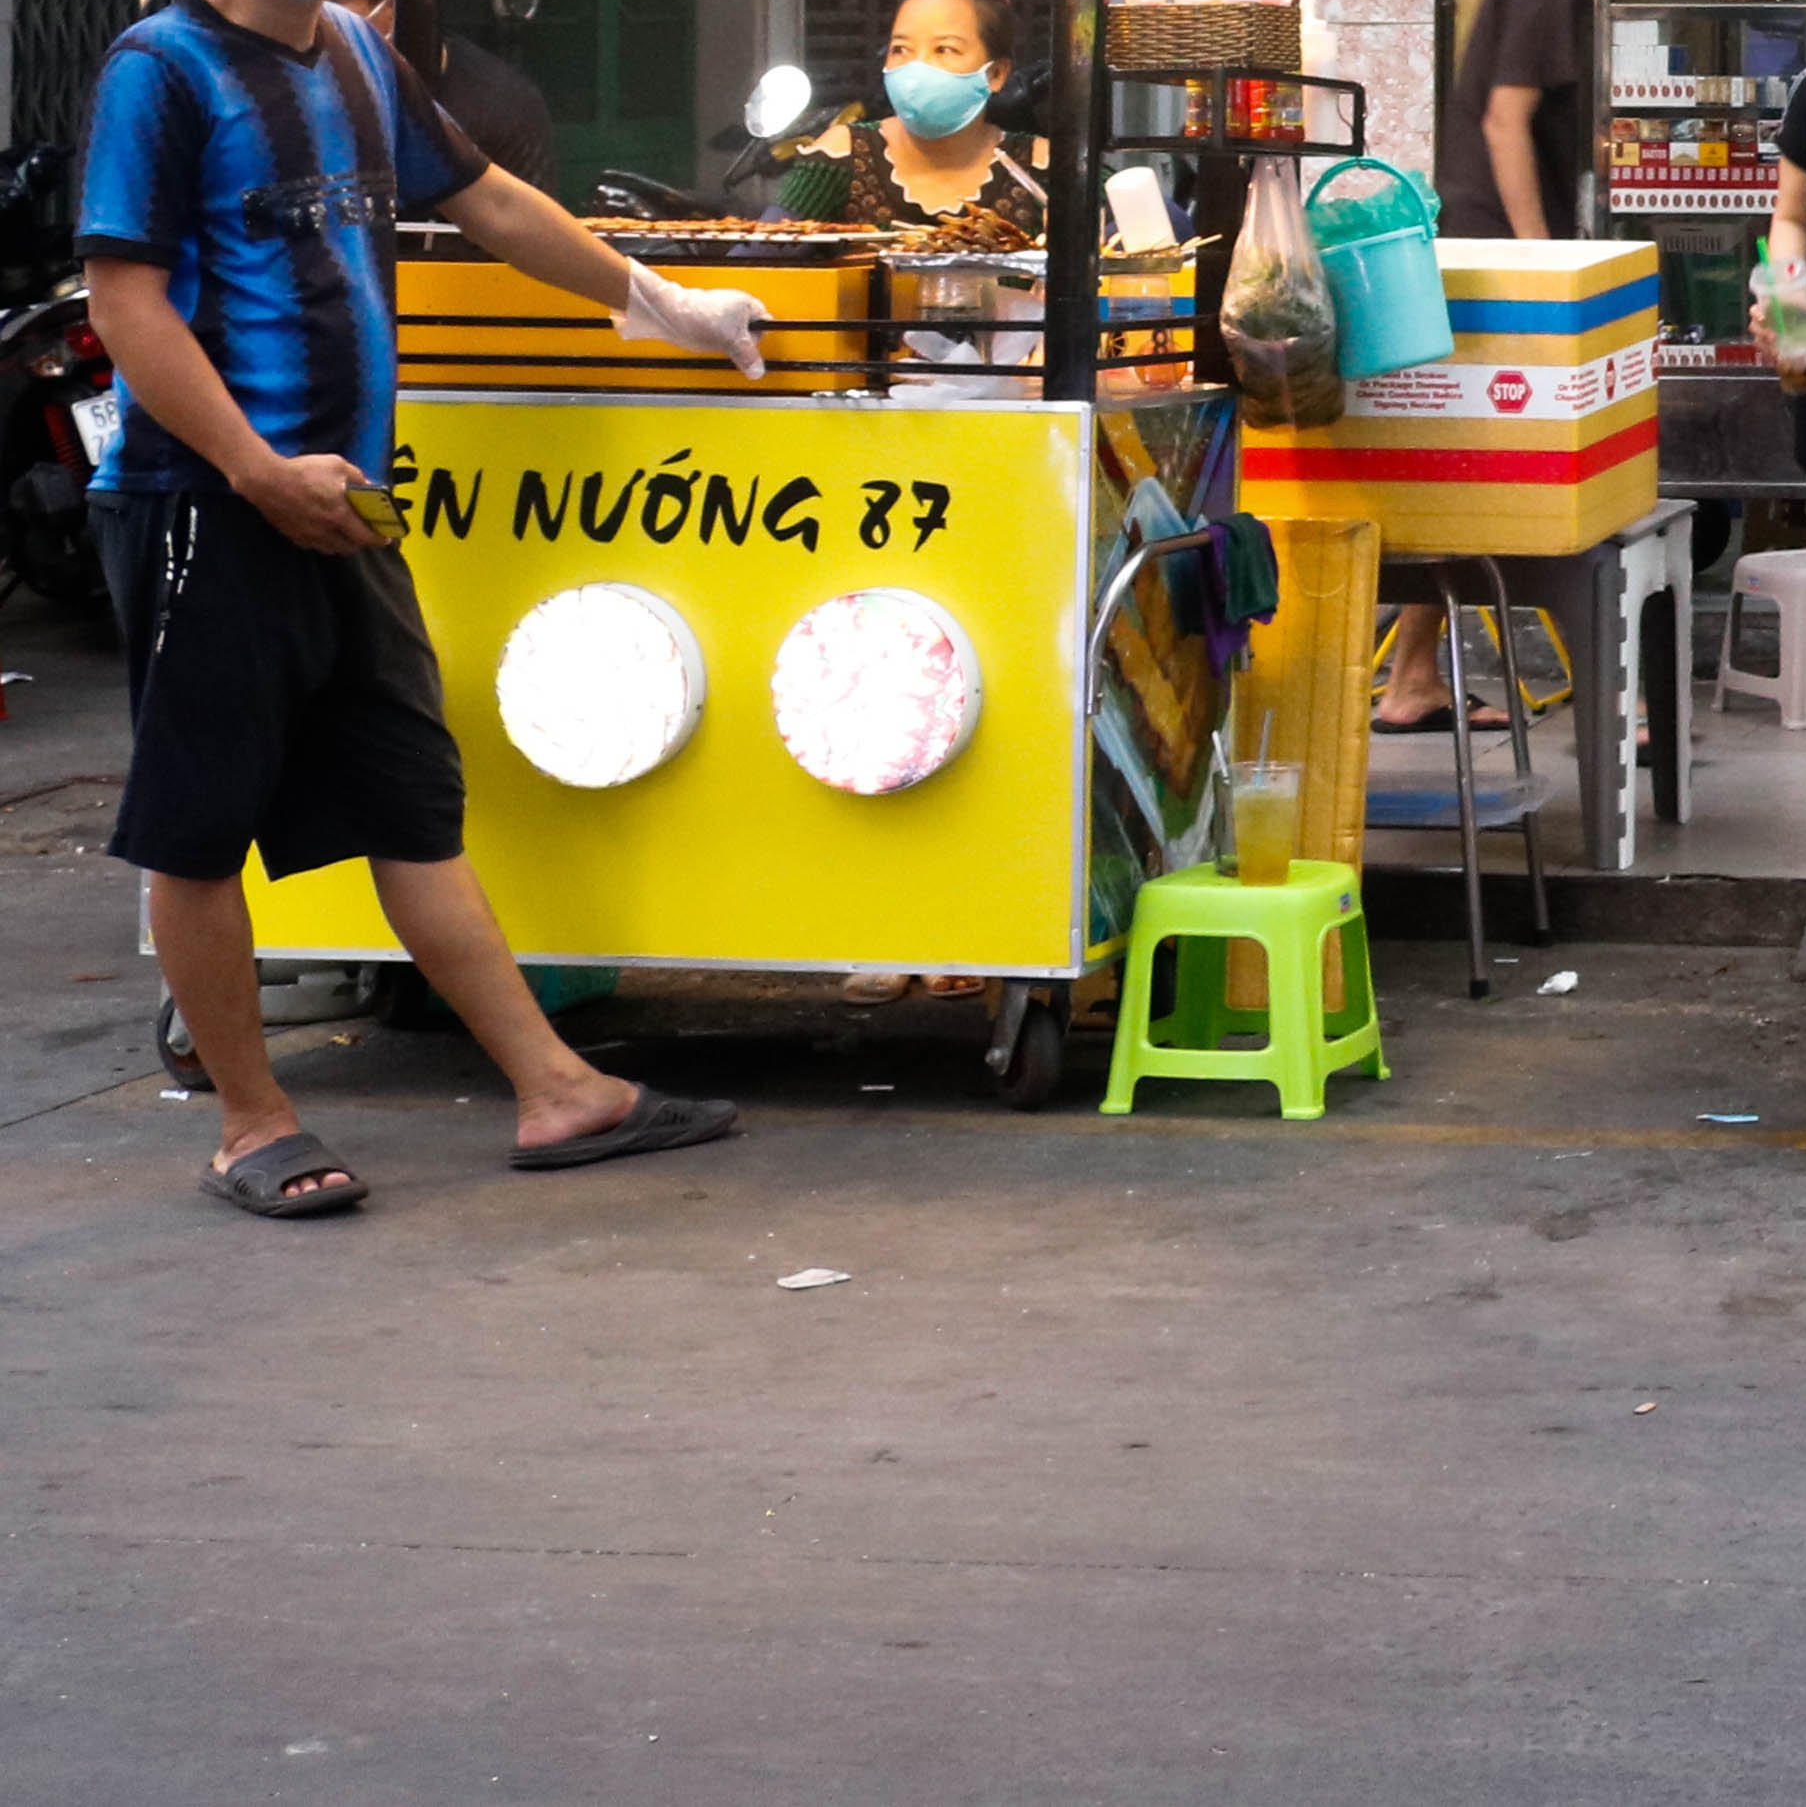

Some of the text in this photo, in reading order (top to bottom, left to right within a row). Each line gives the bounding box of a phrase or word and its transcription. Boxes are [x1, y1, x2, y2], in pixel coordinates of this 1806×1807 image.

[1493, 384, 1526, 401] STOP
[512, 449, 823, 553] NƯỚNG
[857, 480, 952, 553] 87
